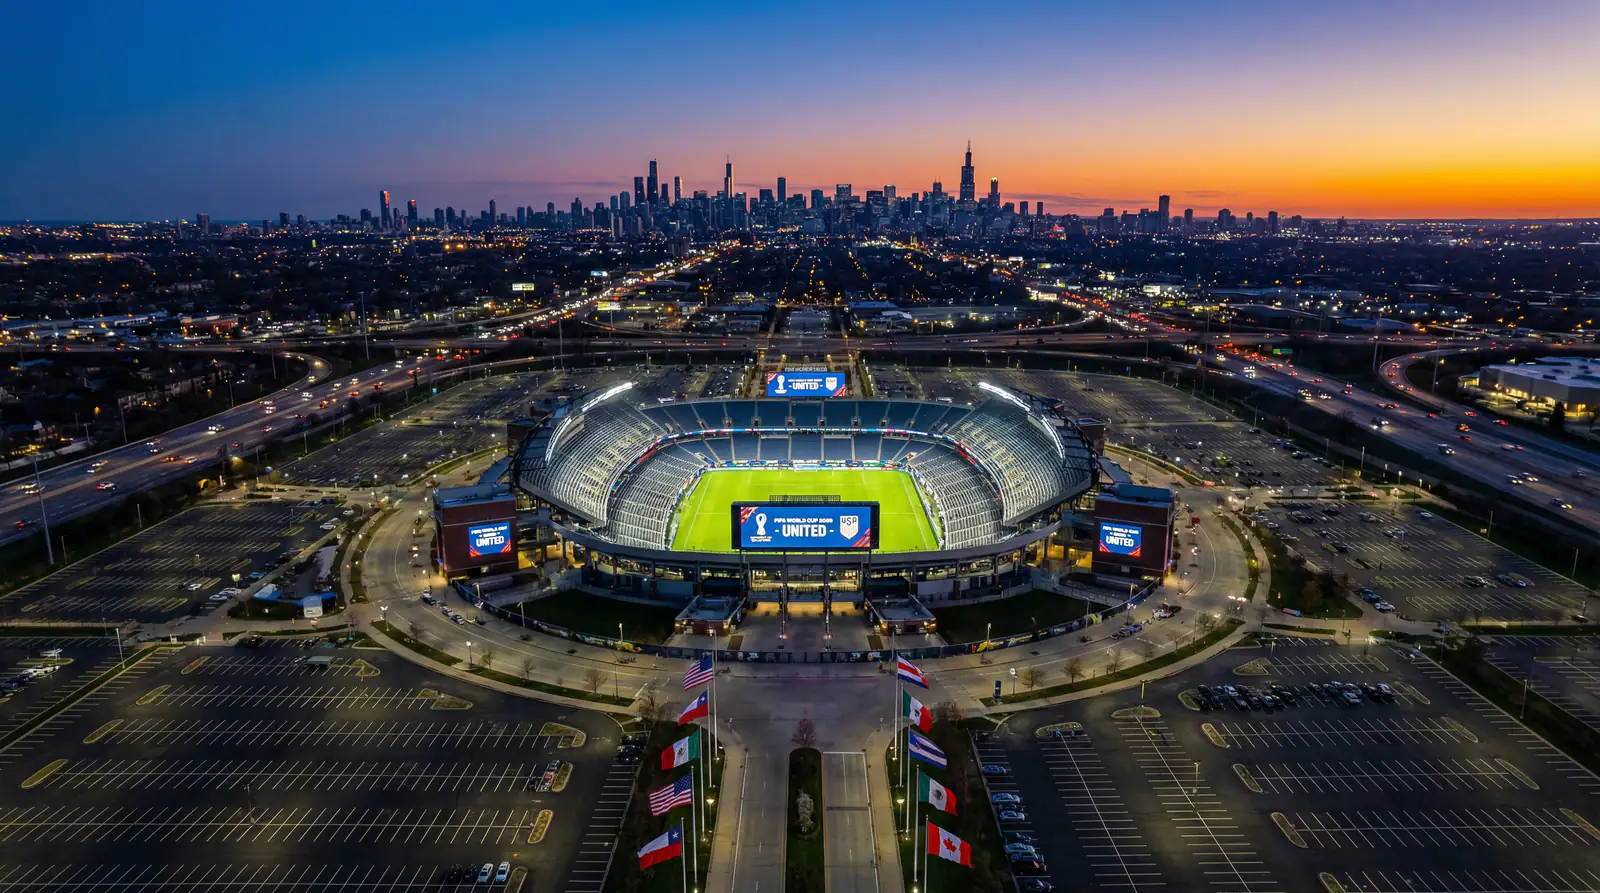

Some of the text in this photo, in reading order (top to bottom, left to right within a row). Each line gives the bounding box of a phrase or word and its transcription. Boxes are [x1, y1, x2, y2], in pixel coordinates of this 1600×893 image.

[793, 382, 818, 390] UNITED
[782, 524, 827, 537] UNITED
[476, 536, 504, 547] UNITED
[1106, 535, 1134, 547] UNITED
